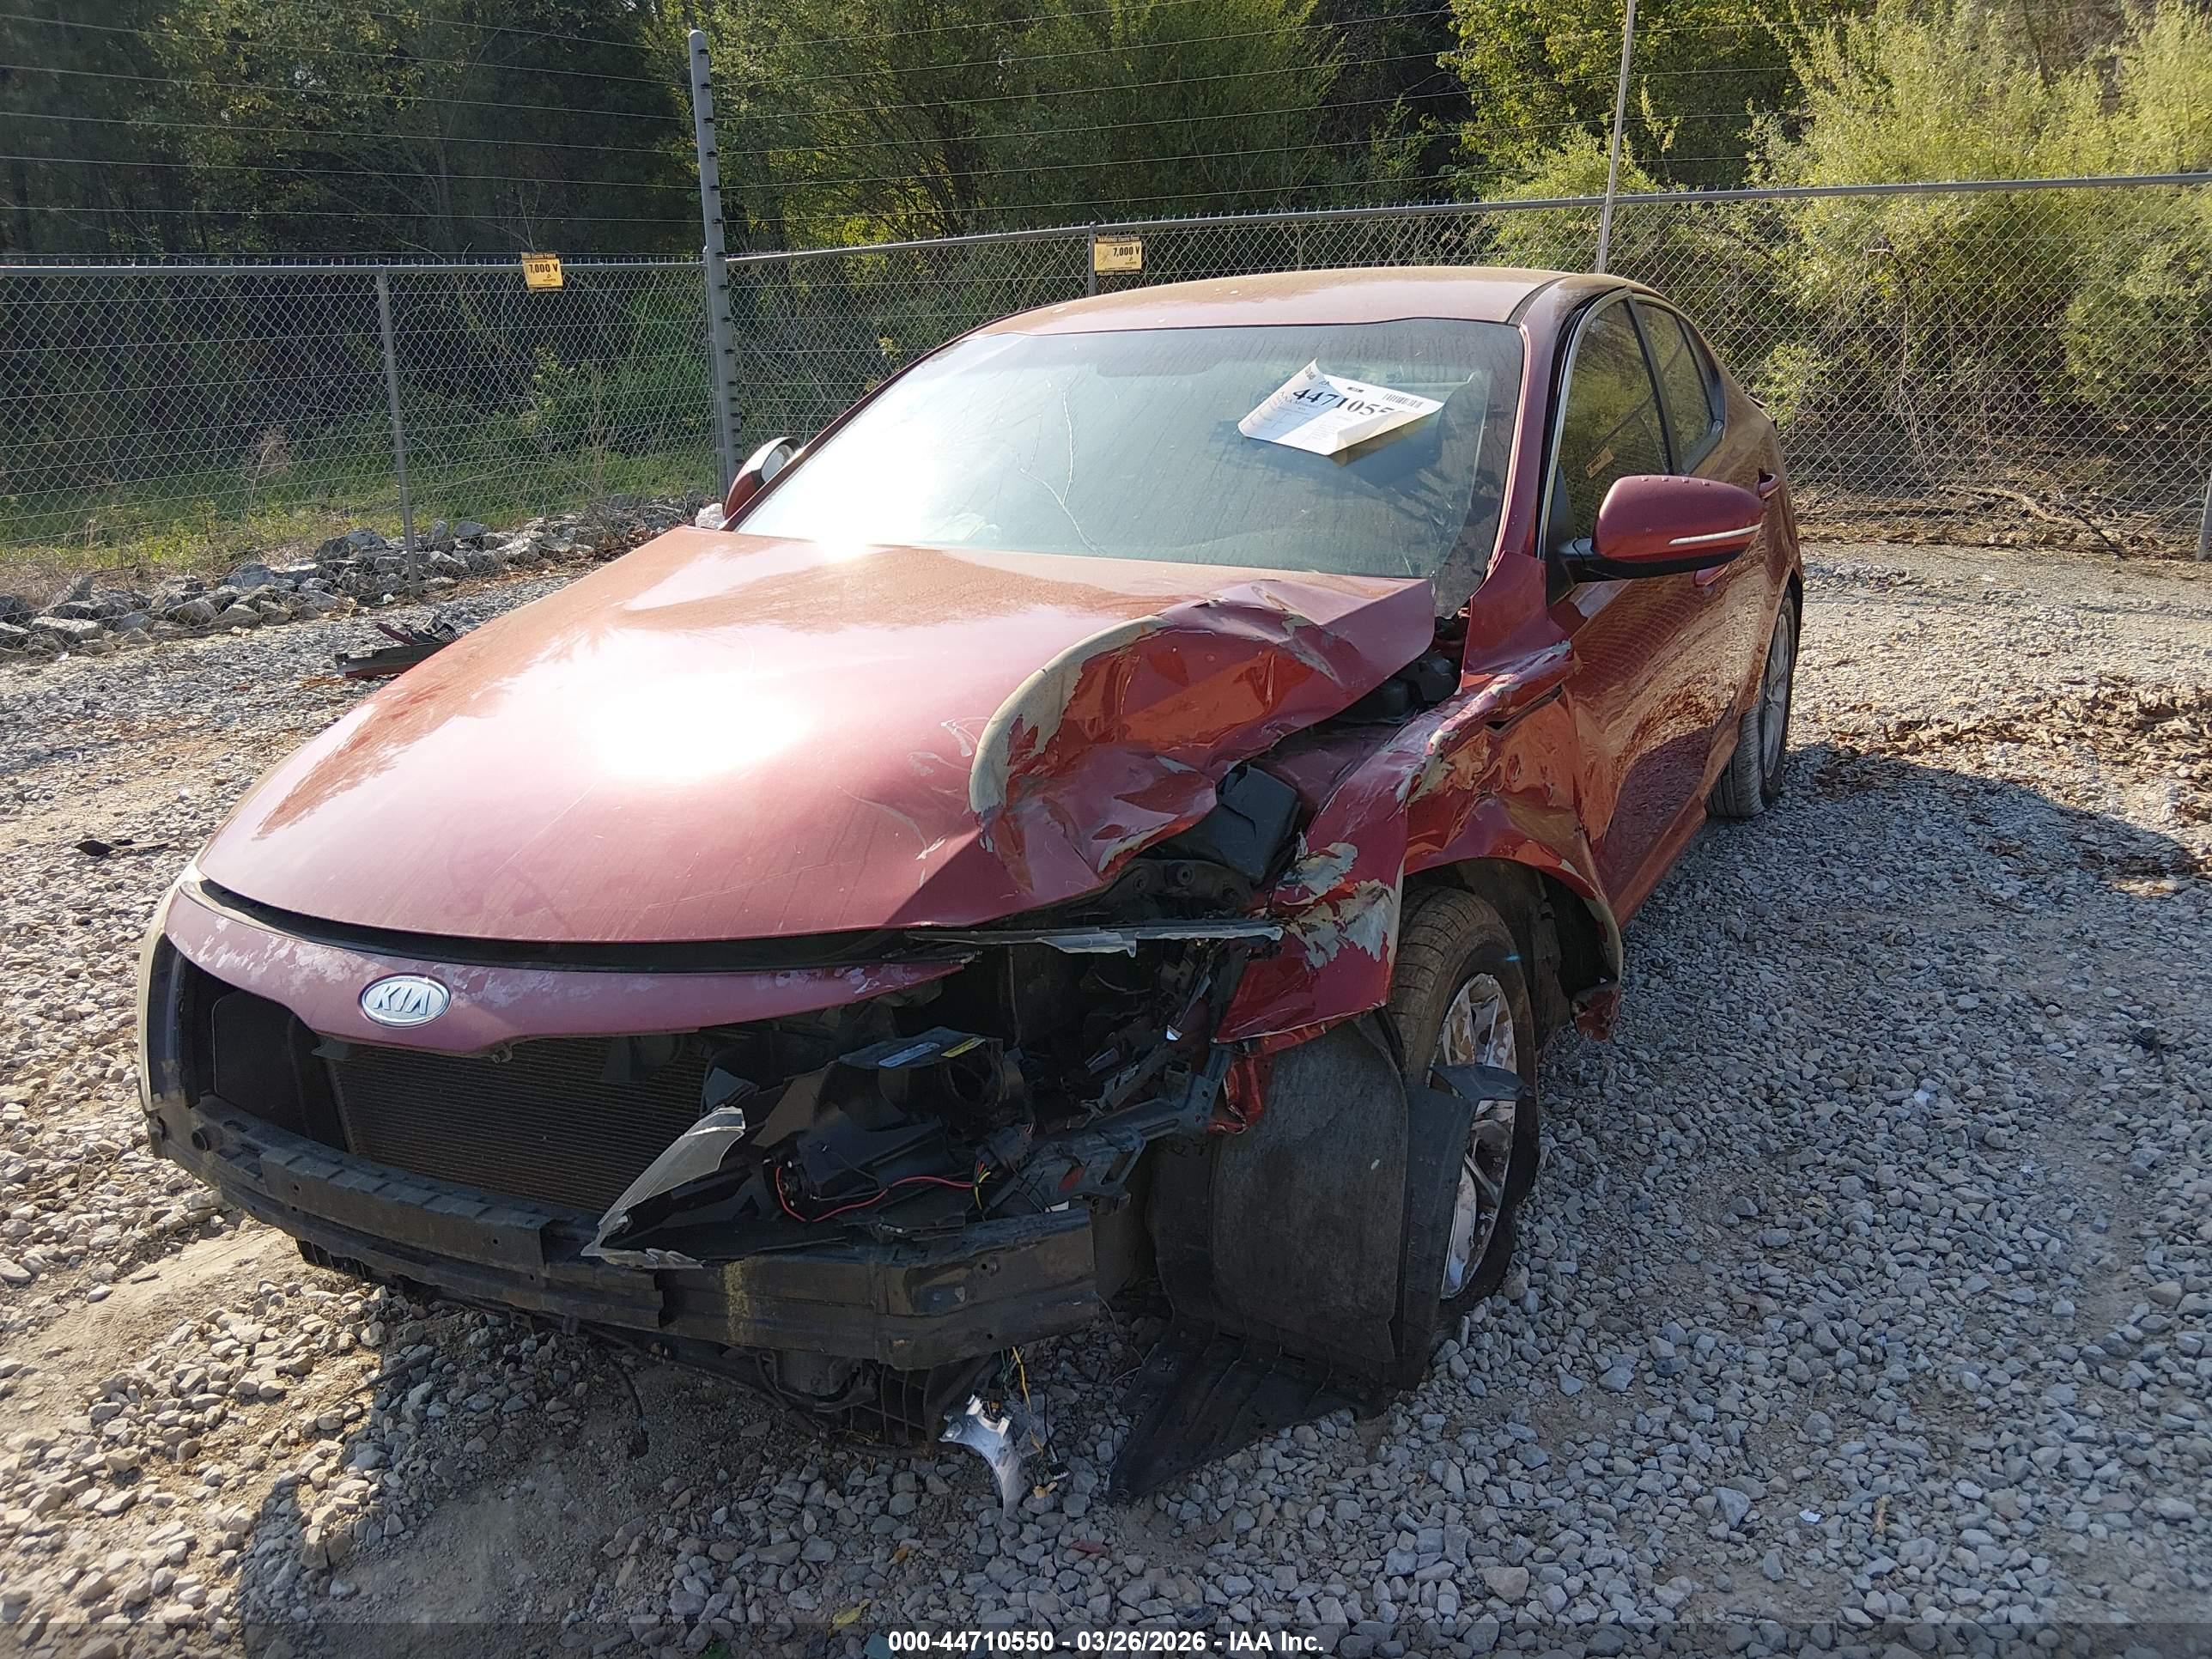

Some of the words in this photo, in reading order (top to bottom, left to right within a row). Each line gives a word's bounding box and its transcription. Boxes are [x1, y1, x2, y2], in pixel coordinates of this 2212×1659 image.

[1113, 246, 1133, 257] 7,000
[1135, 246, 1140, 254] V
[529, 264, 550, 274] 7,000
[552, 264, 558, 272] V
[373, 983, 430, 1015] KIA
